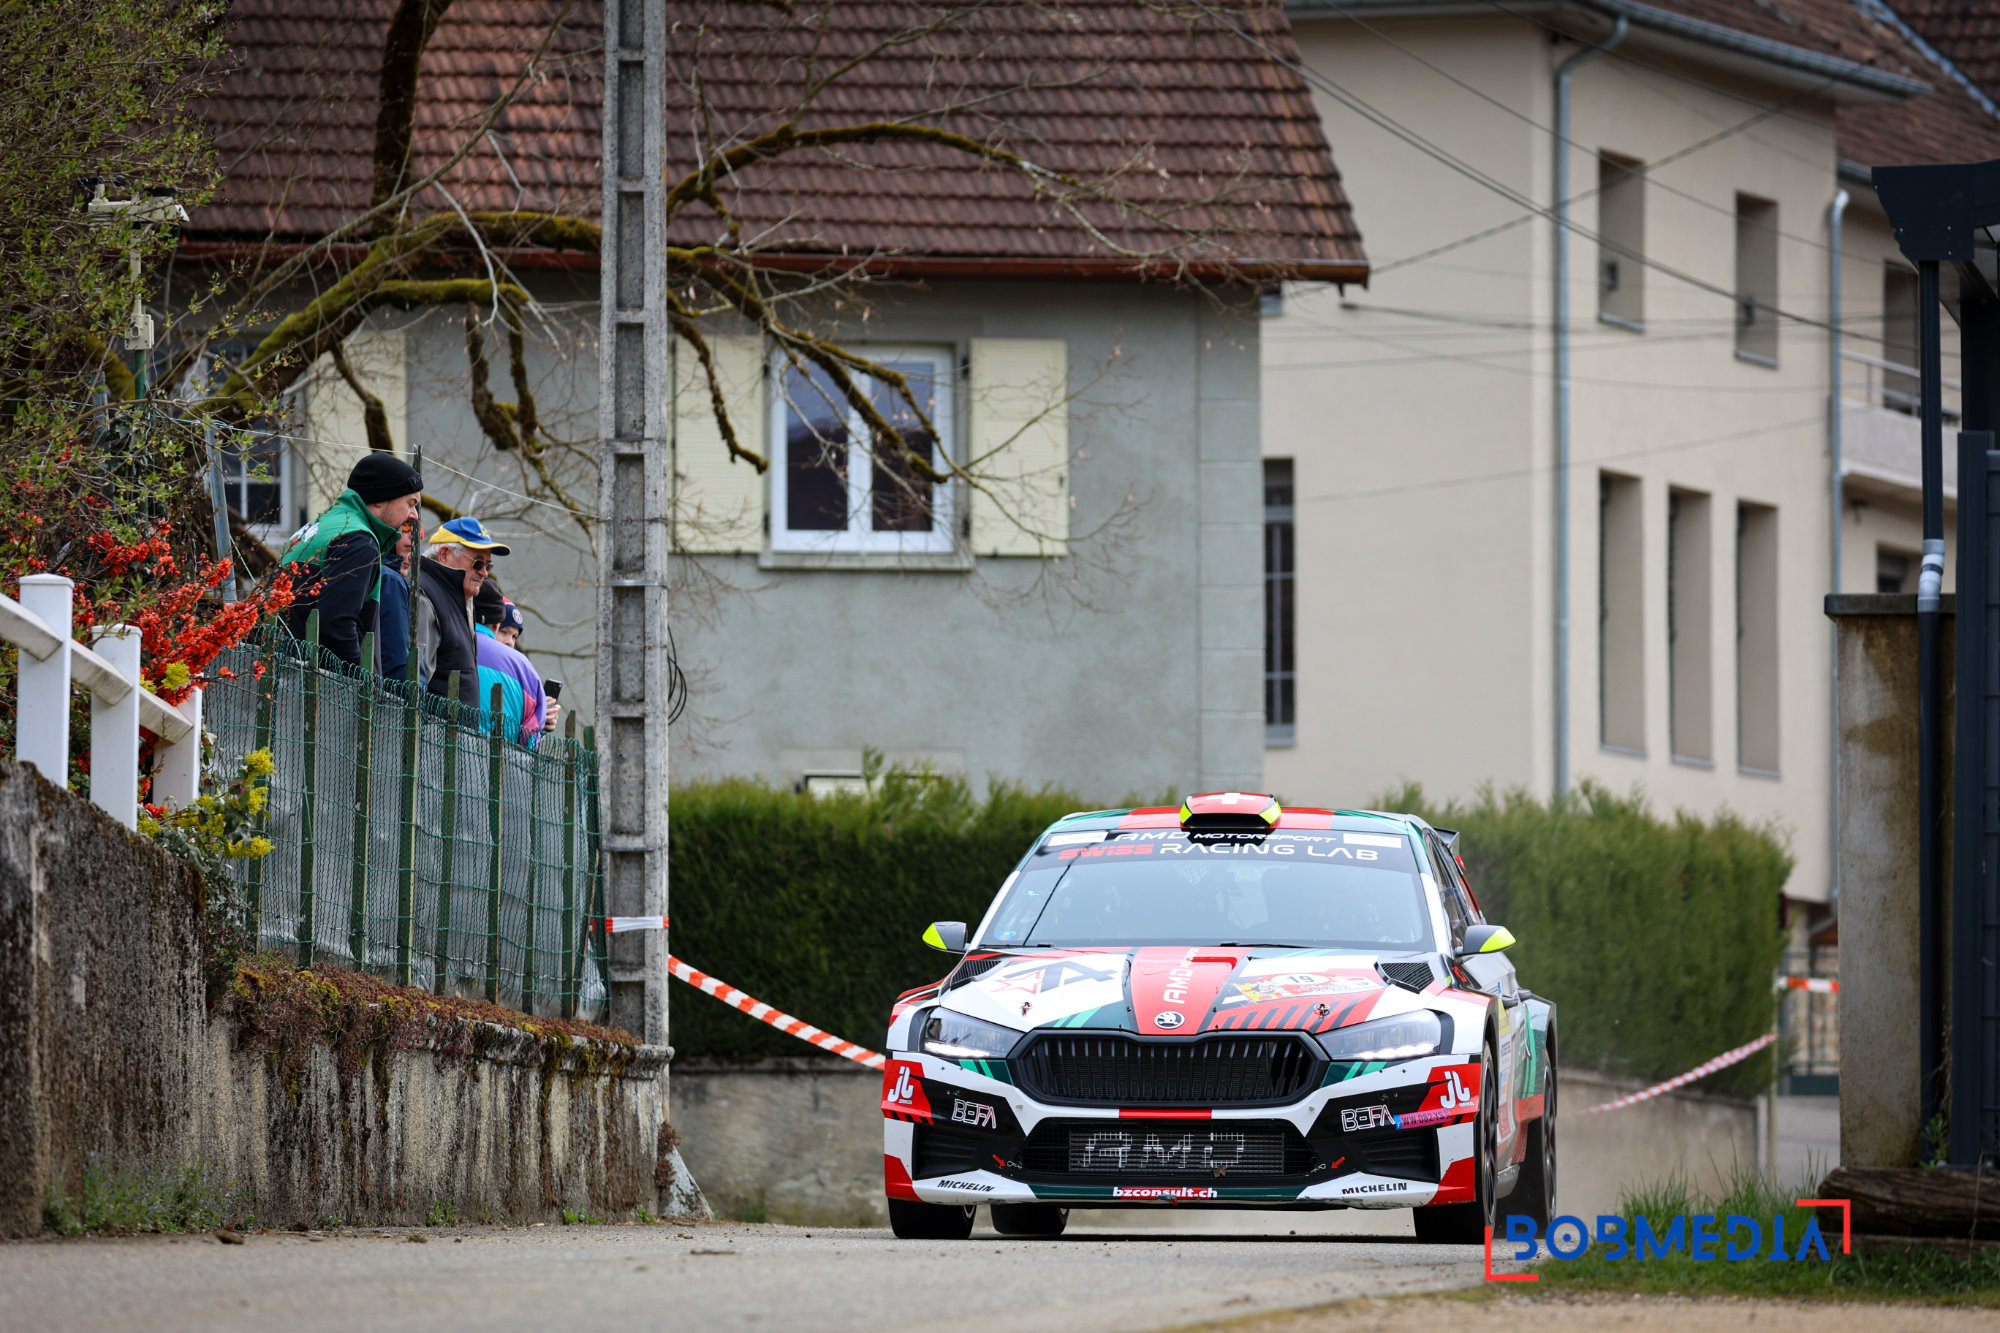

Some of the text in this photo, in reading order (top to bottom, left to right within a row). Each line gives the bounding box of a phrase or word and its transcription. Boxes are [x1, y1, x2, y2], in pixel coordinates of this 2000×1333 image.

[1114, 831, 1191, 842] AMD
[1194, 832, 1337, 843] MOTORSPORT
[1058, 842, 1378, 861] SWISS RACING LAB
[1286, 974, 1315, 984] 19
[1163, 968, 1193, 1005] AMD
[1081, 1132, 1246, 1168] AMD
[937, 1179, 996, 1192] MICHELIN
[1341, 1182, 1408, 1195] MICHELIN
[1113, 1186, 1217, 1199] bzconsult.ch
